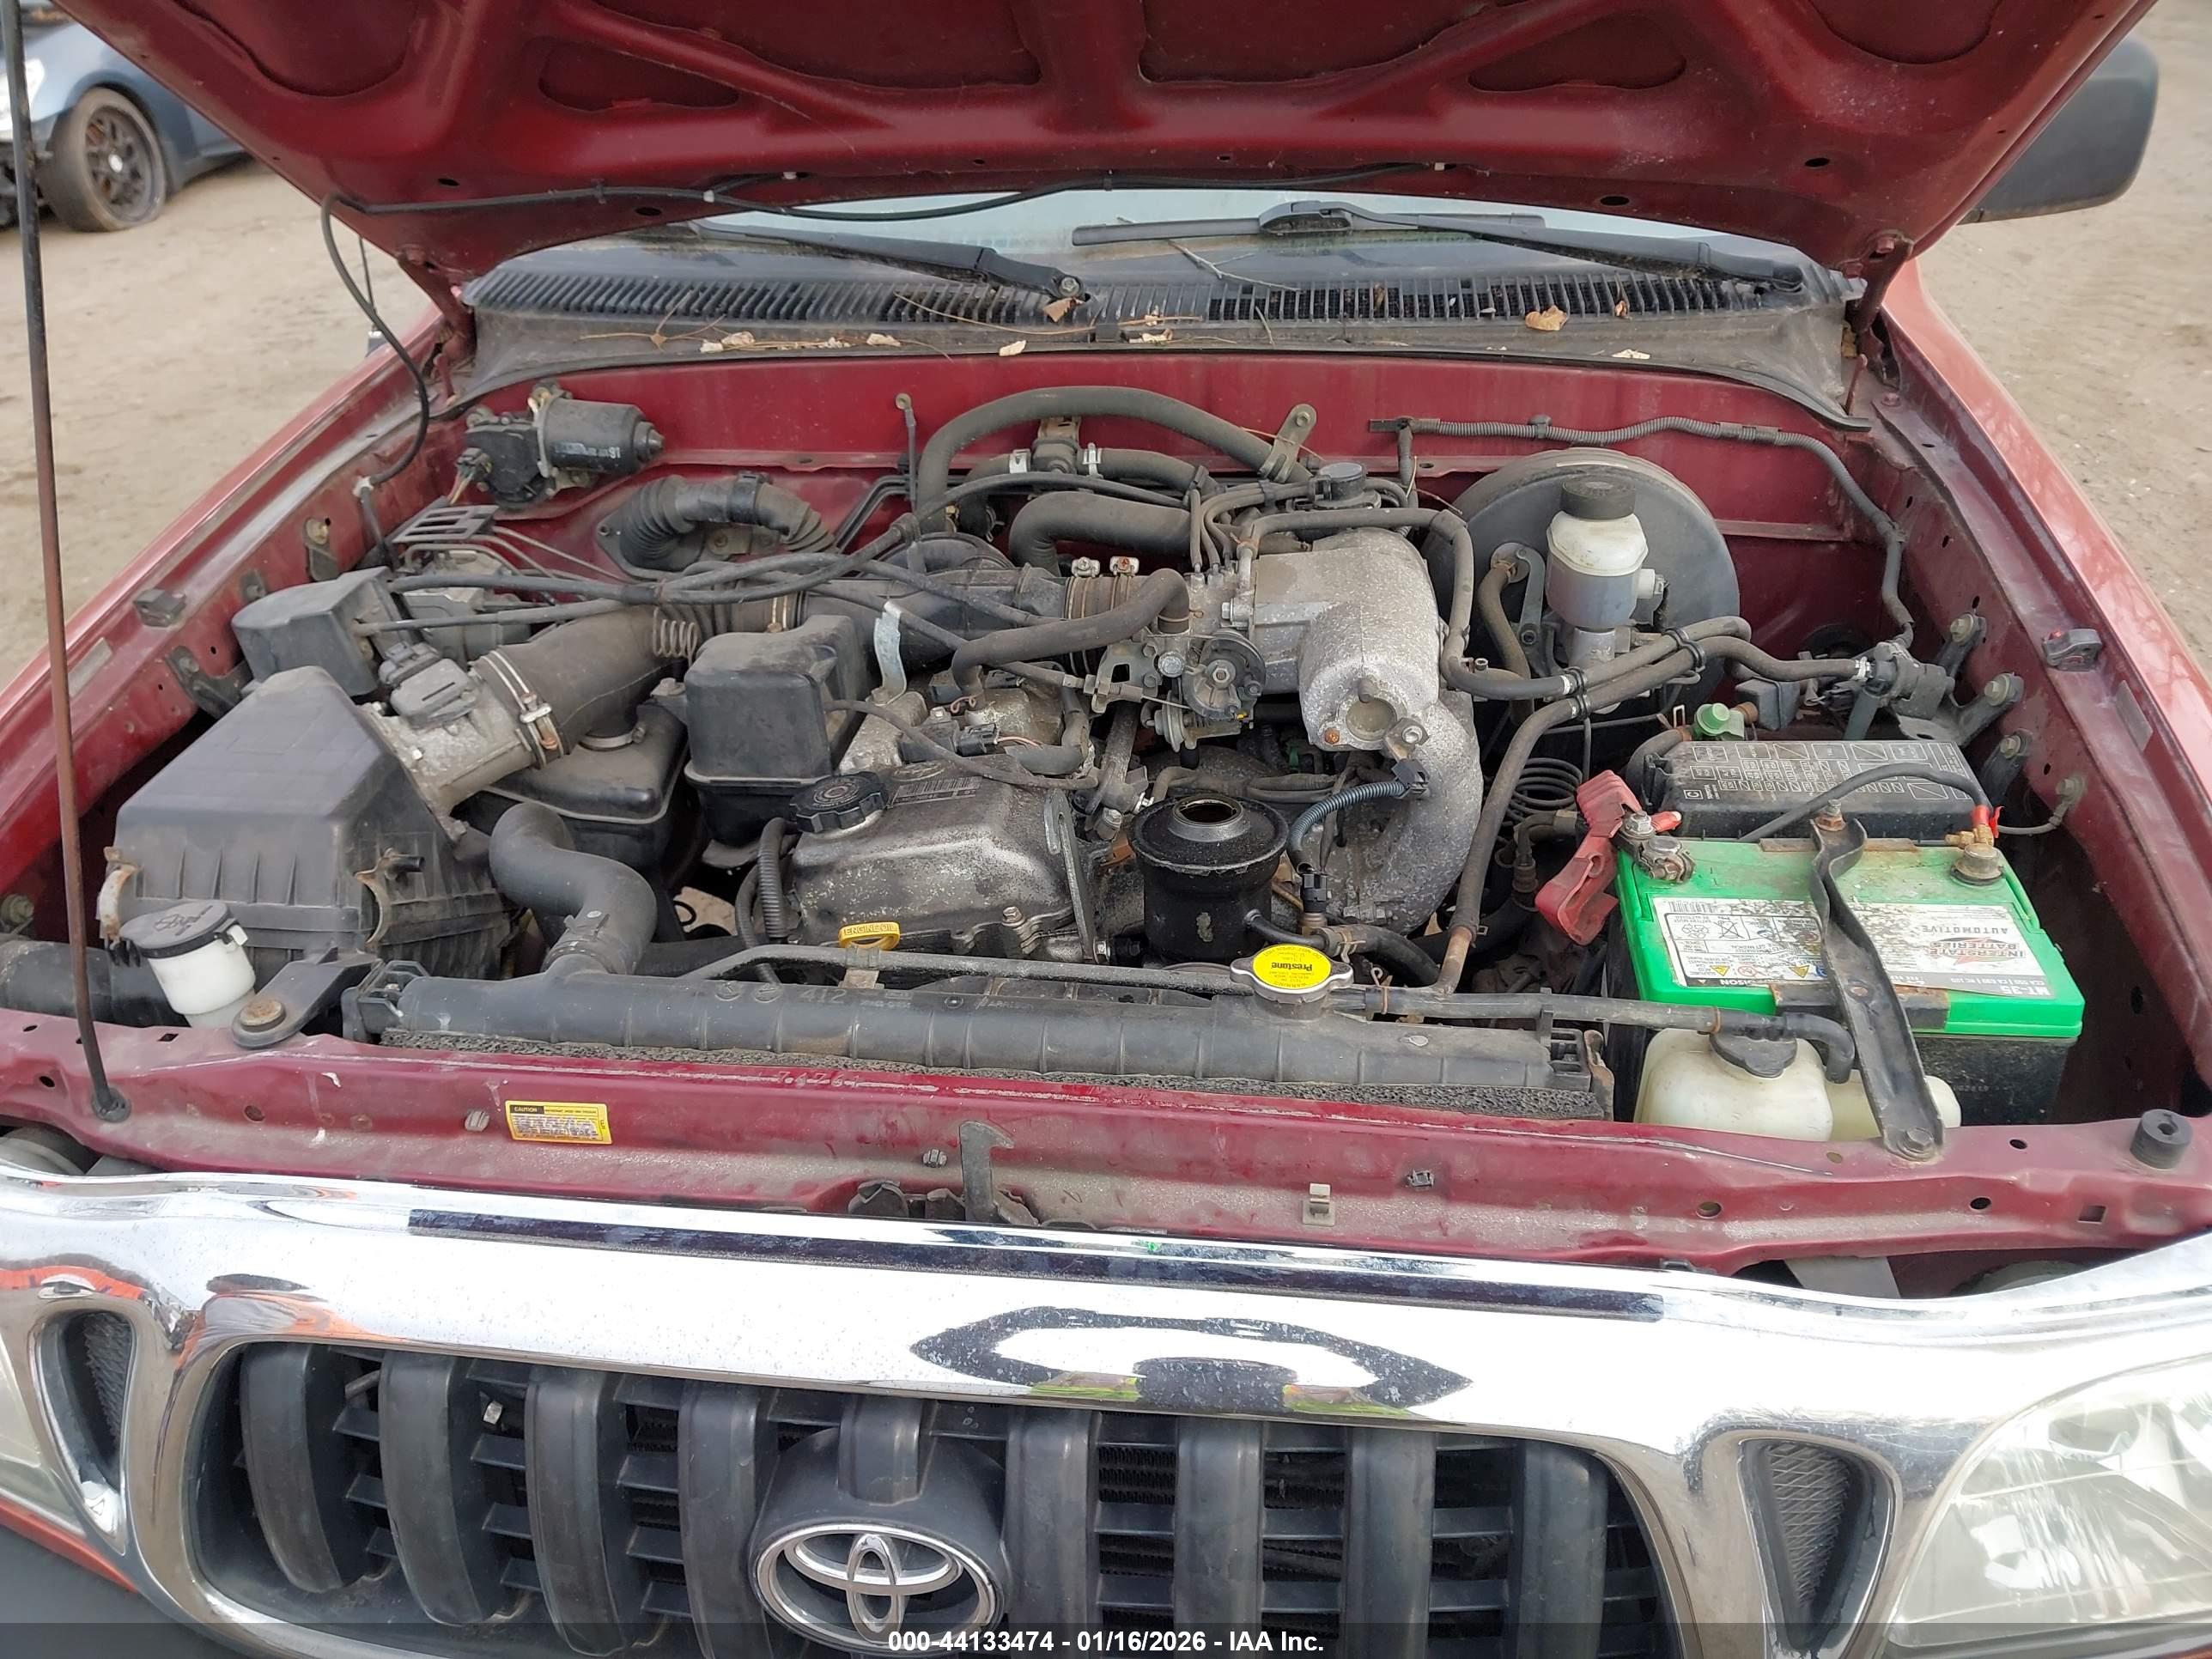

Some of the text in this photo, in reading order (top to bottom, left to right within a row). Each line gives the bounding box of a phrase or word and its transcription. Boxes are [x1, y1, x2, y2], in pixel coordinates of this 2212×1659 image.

[844, 925, 879, 935] ENGINE
[1922, 925, 2008, 934] AUTOMOTIVE
[1929, 948, 2024, 957] INTERSTATE
[1272, 963, 1312, 972] Prestone
[2000, 985, 2051, 996] MT-35
